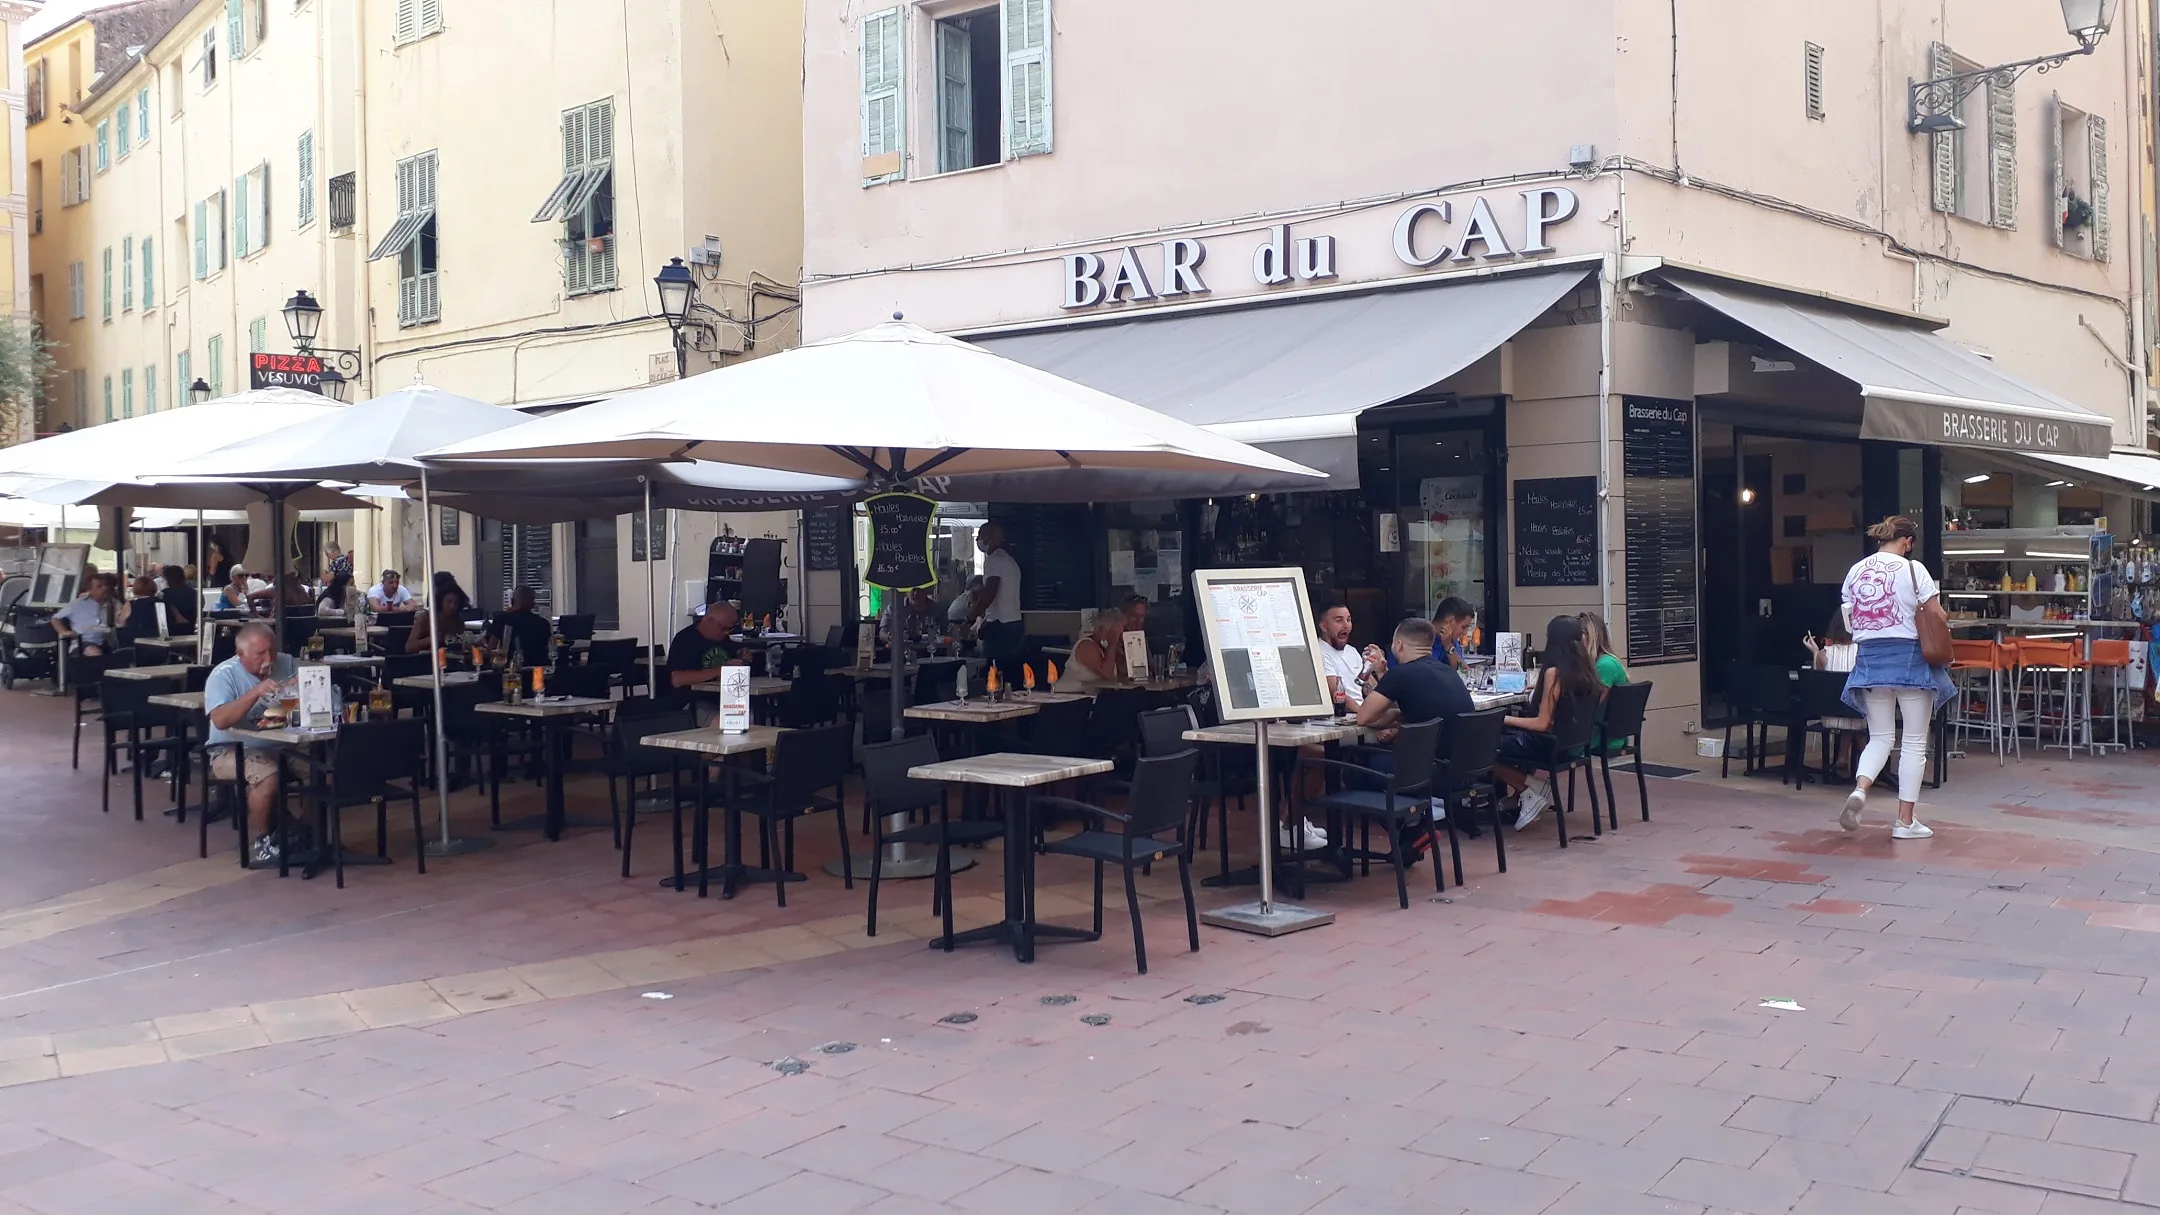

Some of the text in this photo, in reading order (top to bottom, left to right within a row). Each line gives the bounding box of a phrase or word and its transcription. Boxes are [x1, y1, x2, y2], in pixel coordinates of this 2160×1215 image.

[1059, 186, 1579, 310] BAR du CAP
[255, 354, 320, 372] PIZZA
[1629, 404, 1688, 425] Brasserie du Cap
[1943, 412, 2059, 447] BRASSERIE DU CAP
